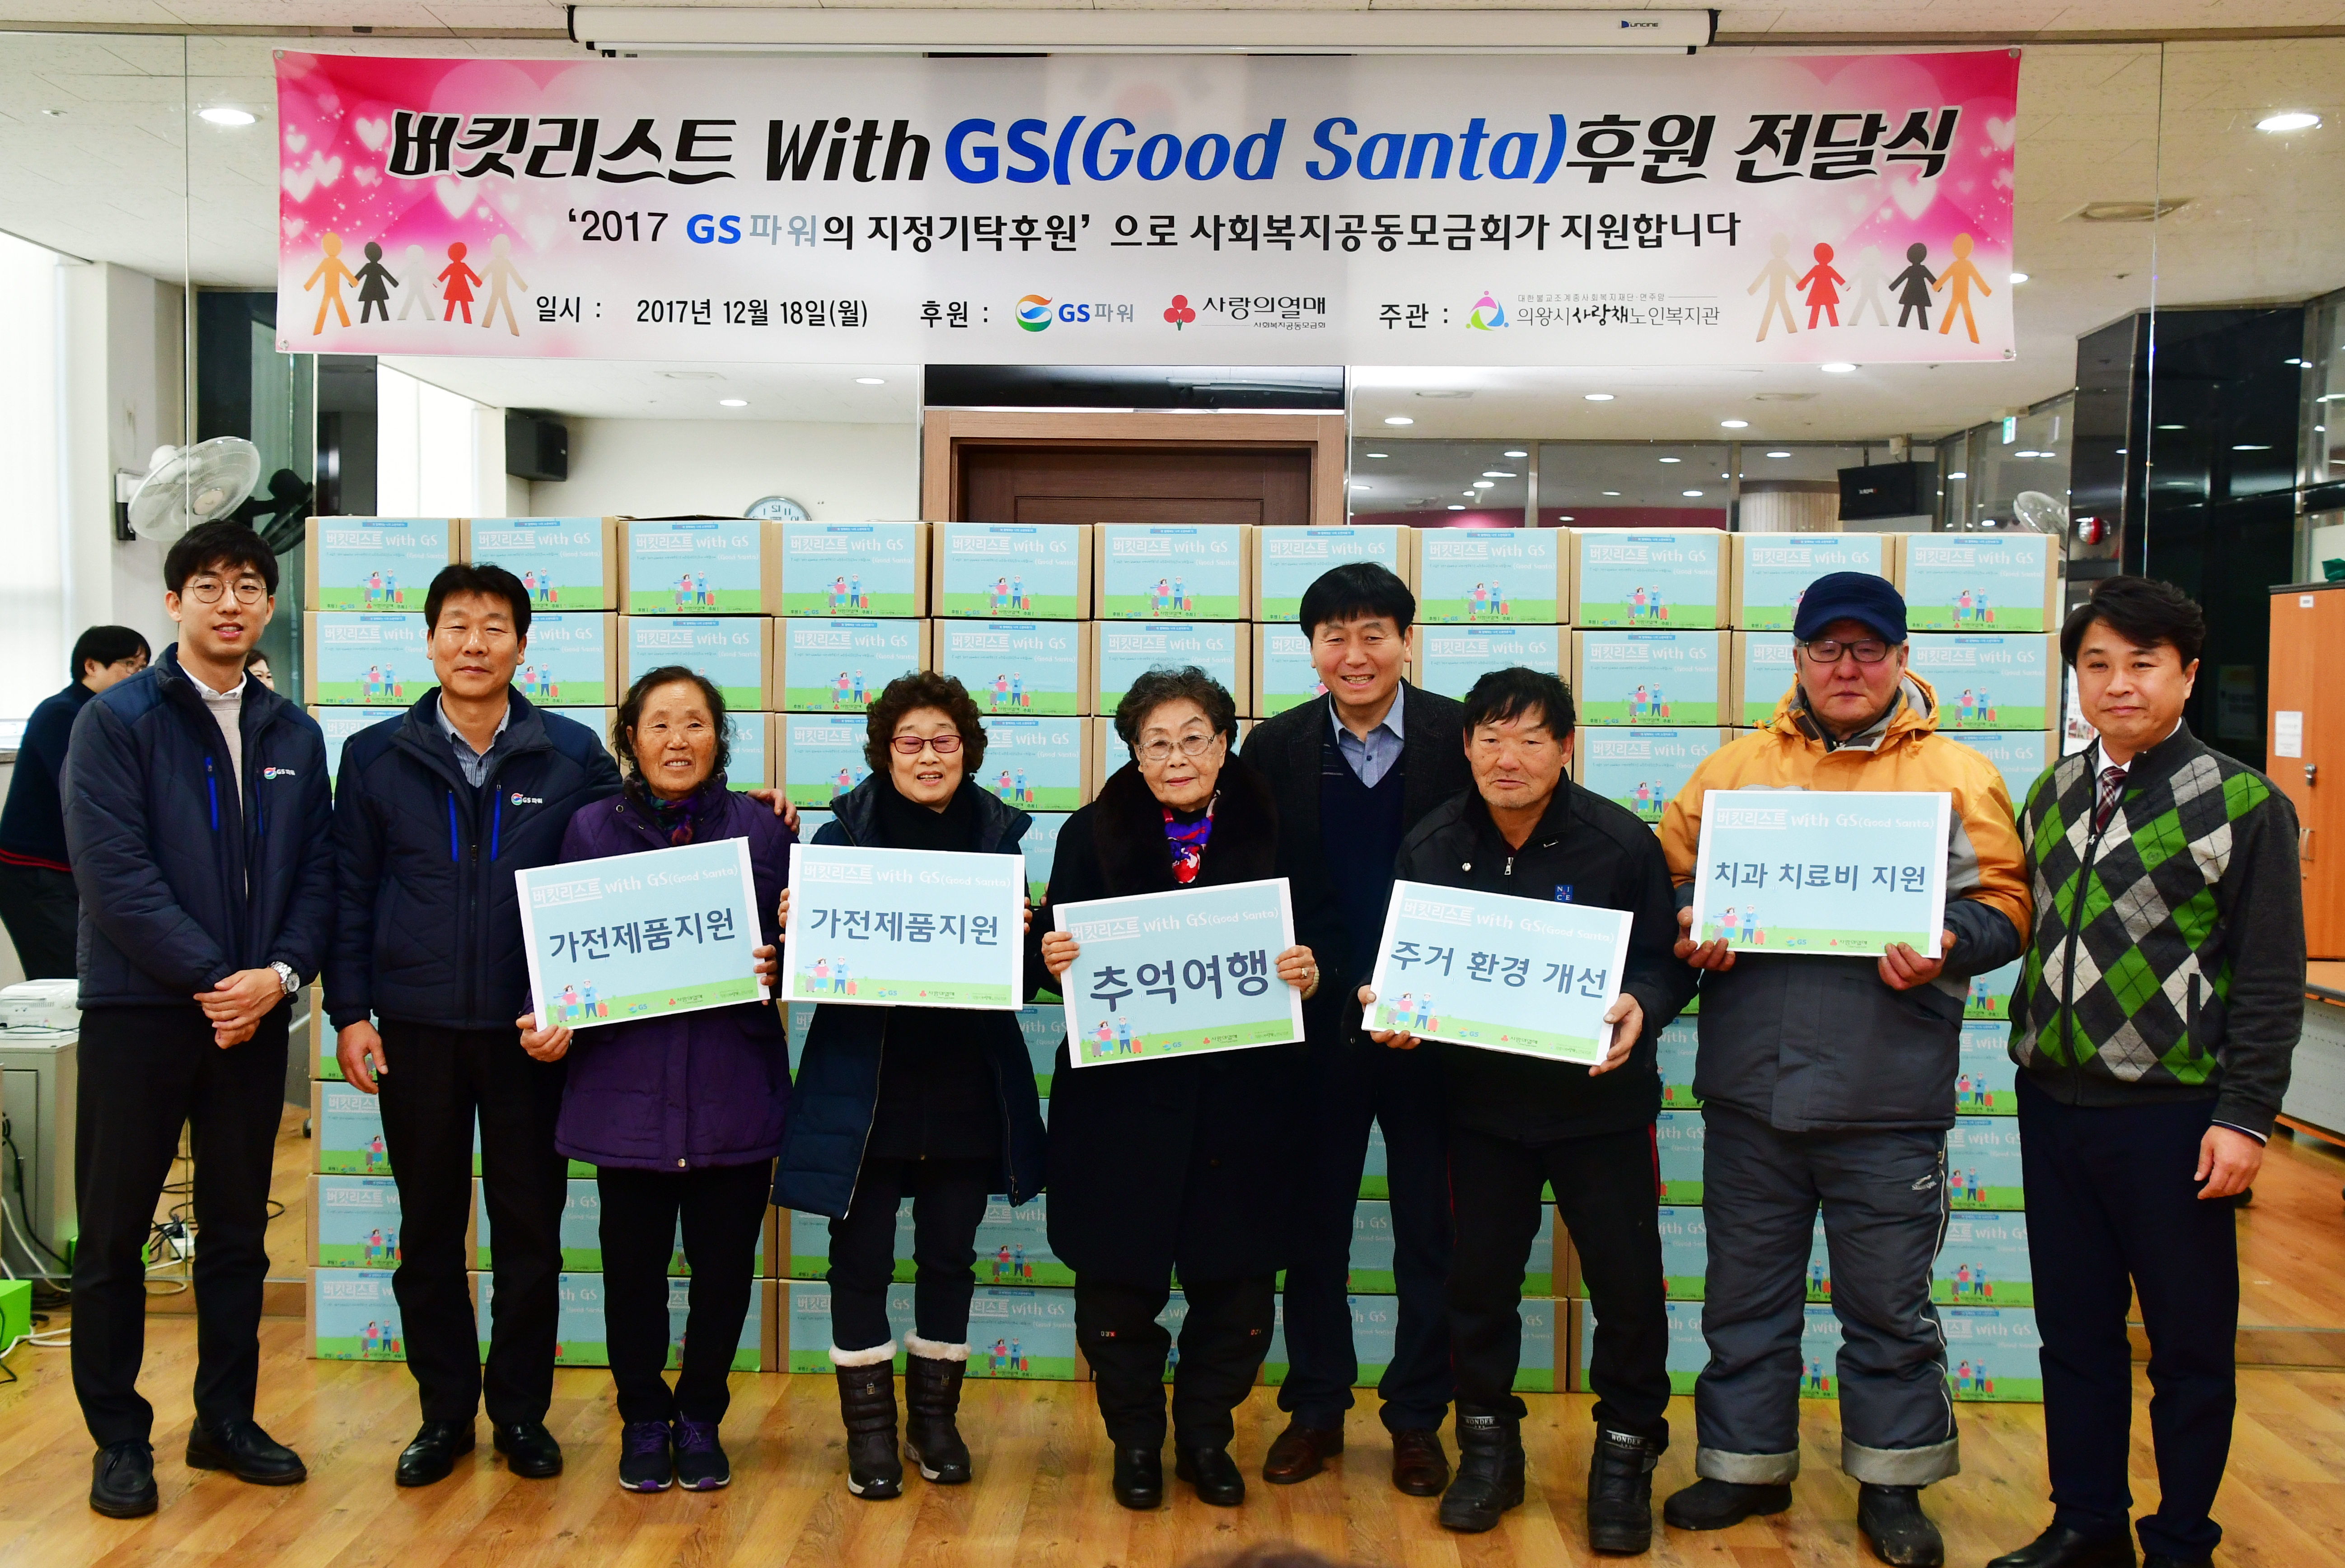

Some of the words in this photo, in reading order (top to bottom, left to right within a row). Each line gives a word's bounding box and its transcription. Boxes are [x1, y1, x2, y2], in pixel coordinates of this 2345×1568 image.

[389, 112, 736, 184] 버킷리스트
[767, 117, 930, 182] With
[1734, 110, 1958, 183] 전달식
[1111, 215, 1177, 246] 으로
[1190, 215, 1549, 252] 사회복지공동모금회가
[1561, 212, 1741, 249] 지원합니다
[537, 296, 580, 322] 일시
[637, 299, 711, 325] 2017년
[724, 300, 768, 326] 12월
[781, 300, 866, 327] 18일(월)
[921, 301, 967, 327] 후원
[1203, 297, 1325, 320] 사랑의열매
[1380, 303, 1428, 329] 주관
[1254, 322, 1325, 331] 사회복지공동모금회
[385, 533, 416, 547] with
[421, 534, 438, 546] GS
[538, 532, 569, 546] with
[573, 532, 591, 545] GS
[696, 535, 727, 549] with
[731, 535, 749, 548] GS
[851, 538, 881, 552] with
[886, 538, 904, 551] GS
[1014, 539, 1044, 553] with
[1049, 540, 1067, 553] GS
[1174, 540, 1205, 554] with
[1210, 541, 1228, 554] GS
[1332, 541, 1362, 555] with
[1367, 542, 1385, 555] GS
[1490, 543, 1523, 558] with
[1527, 544, 1545, 557] GS
[1651, 548, 1684, 563] with
[1688, 549, 1707, 563] GS
[1814, 550, 1847, 565] with
[1851, 551, 1869, 564] GS
[1978, 551, 2011, 565] with
[2015, 551, 2034, 565] GS
[384, 627, 414, 641] with
[540, 627, 571, 641] with
[575, 627, 593, 640] GS
[697, 632, 727, 646] with
[732, 632, 750, 645] GS
[855, 634, 885, 648] with
[890, 635, 908, 648] GS
[1013, 636, 1044, 650] with
[1048, 637, 1067, 650] GS
[1170, 637, 1201, 651] with
[1205, 638, 1224, 652] GS
[1492, 640, 1524, 655] with
[1528, 641, 1547, 655] GS
[1652, 646, 1684, 661] with
[1688, 647, 1707, 661] GS
[1979, 649, 2012, 664] with
[2016, 650, 2035, 664] GS
[1016, 732, 1047, 746] with
[1051, 733, 1069, 746] GS
[1654, 743, 1686, 758] with
[1690, 743, 1709, 757] GS
[2014, 747, 2033, 761] GS
[1717, 811, 1786, 826] 버킷리스트
[1791, 812, 1829, 827] with
[804, 865, 871, 881] 버킷리스트
[877, 869, 913, 884] with
[1715, 862, 1768, 888] 치과
[1779, 864, 1858, 891] 치료비
[1872, 866, 1924, 892] 지원
[533, 882, 600, 904] 버킷리스트
[605, 877, 641, 894] with
[1404, 902, 1472, 922] 버킷리스트
[1477, 914, 1513, 929] with
[811, 909, 997, 945] 가전제품지원
[1070, 920, 1140, 939] 버킷리스트
[1143, 915, 1180, 932] with
[550, 908, 735, 963] 가전제품지원
[1391, 941, 1454, 976] 주거
[1467, 952, 1529, 987] 환경
[1543, 963, 1606, 998] 개선
[1090, 950, 1268, 1012] 추억여행
